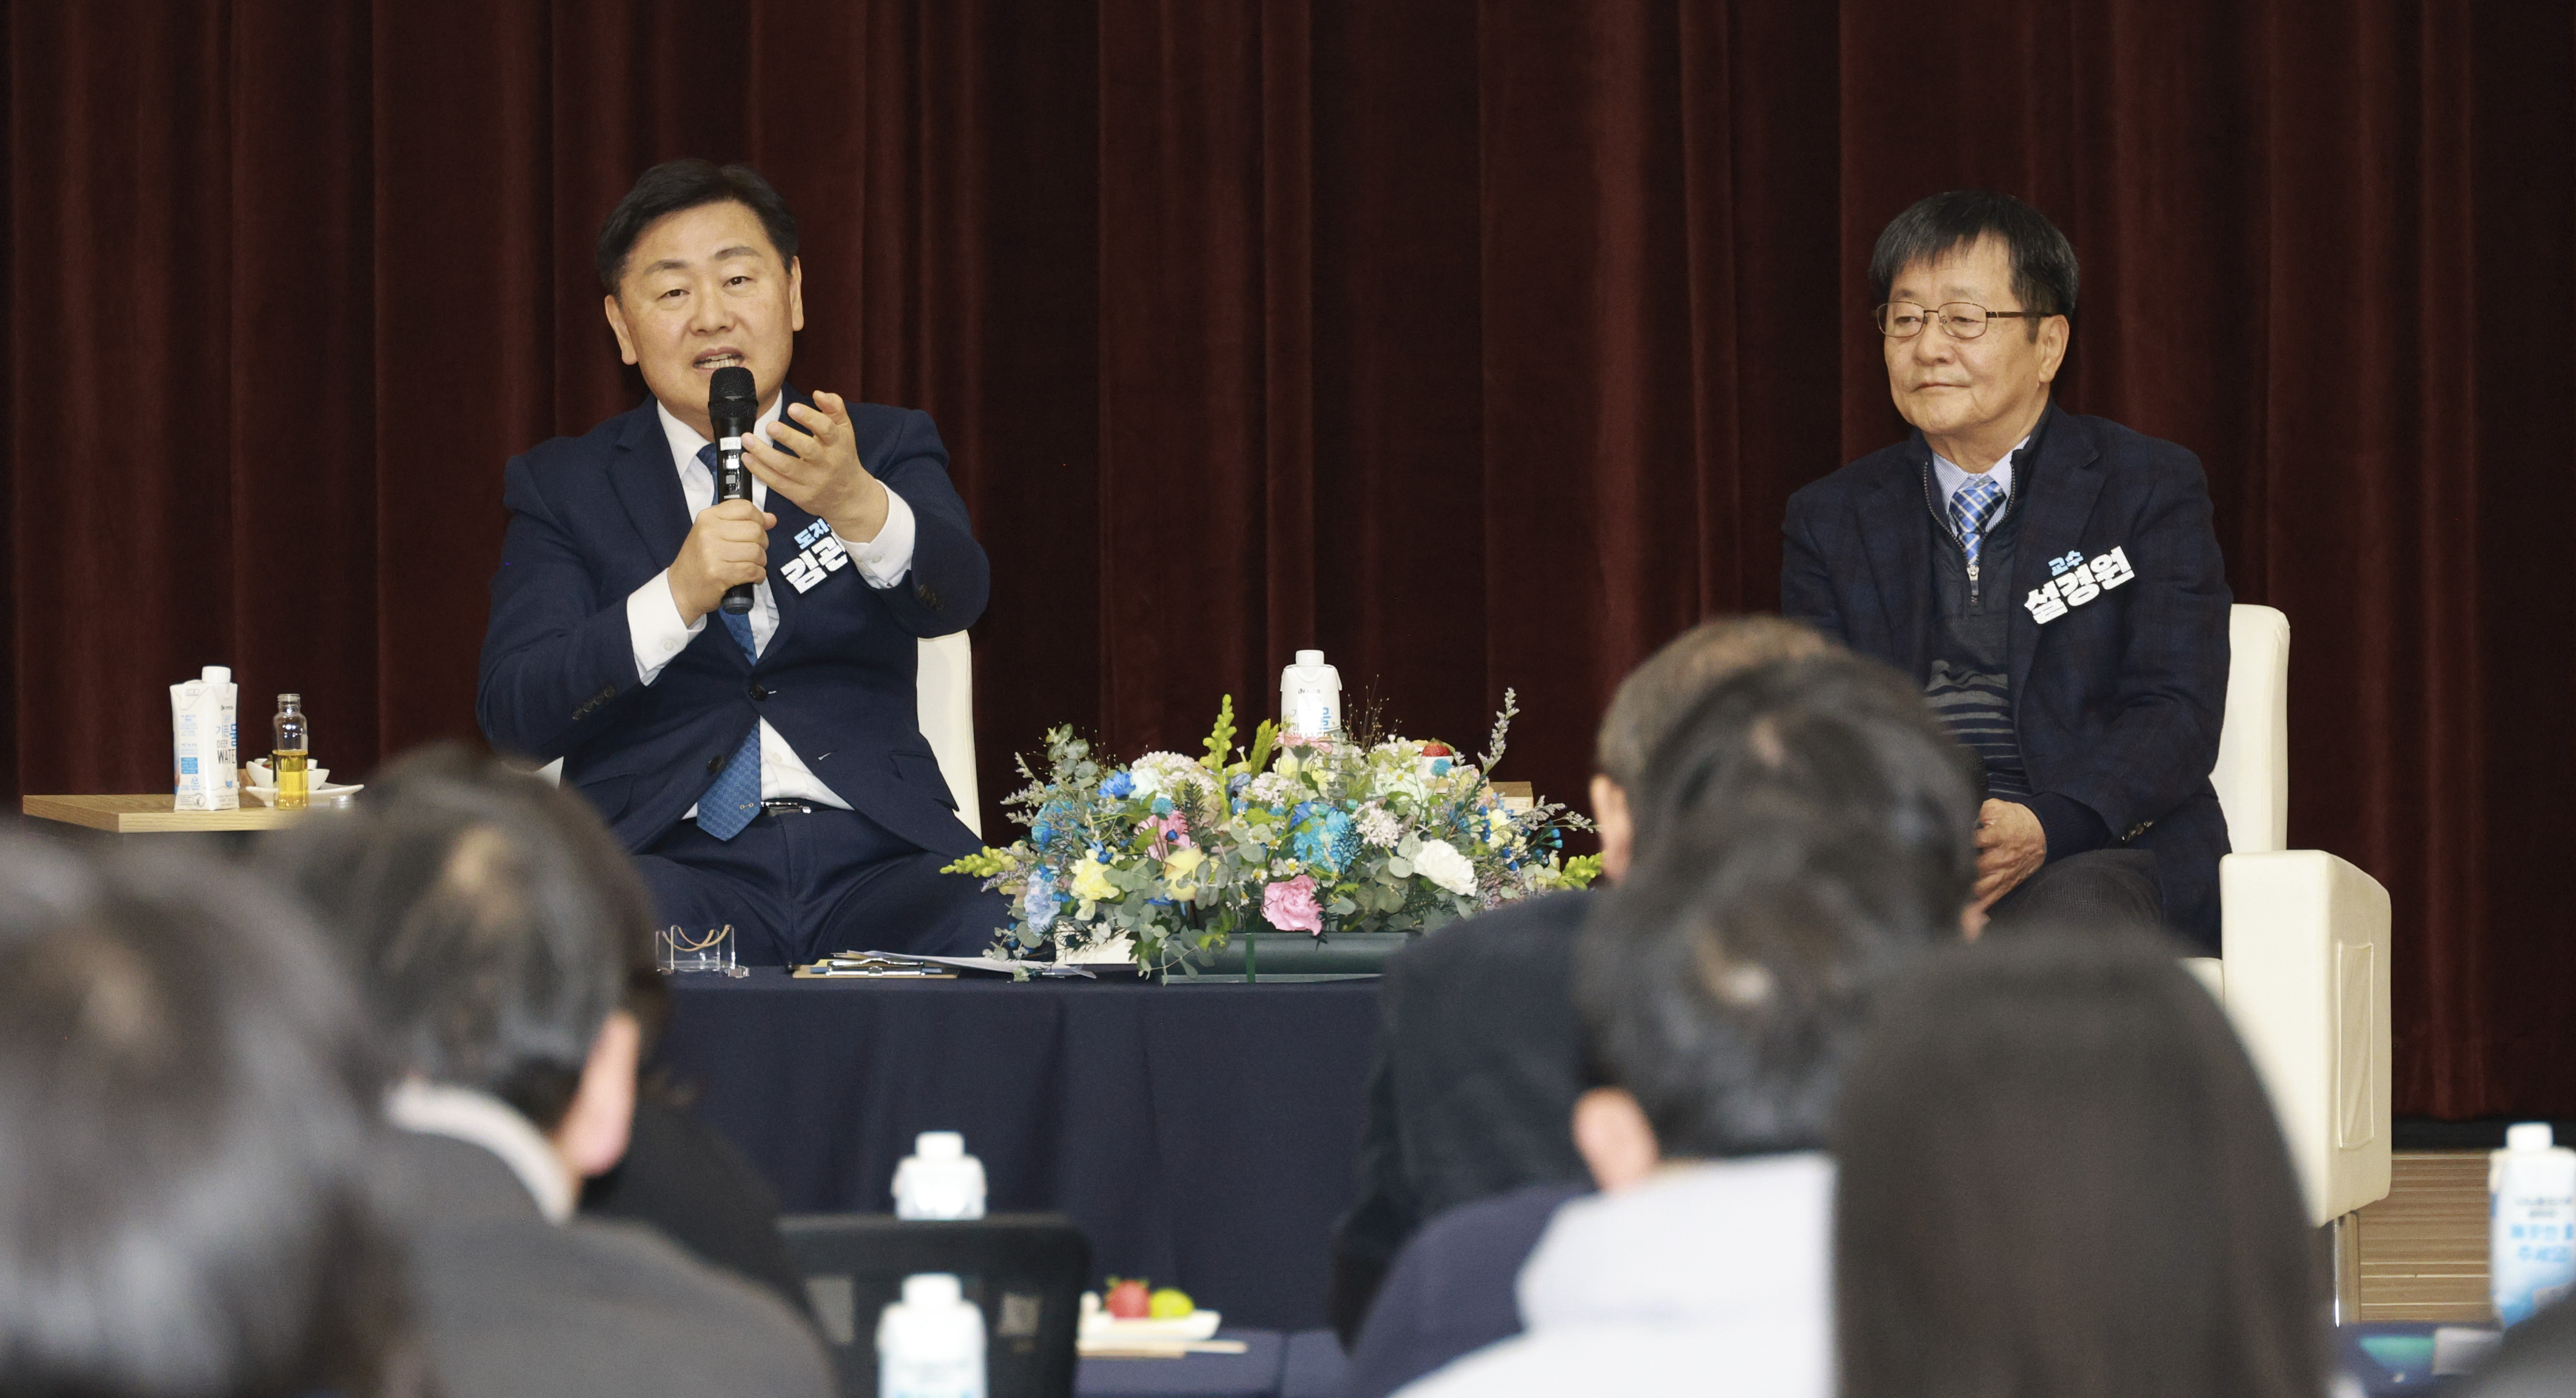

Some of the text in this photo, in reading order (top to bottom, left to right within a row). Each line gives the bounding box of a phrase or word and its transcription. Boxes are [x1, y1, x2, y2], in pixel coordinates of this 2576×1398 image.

[794, 518, 830, 550] 도지
[2048, 550, 2084, 576] 교수
[2024, 546, 2135, 624] 설경원
[217, 740, 228, 748] DEEP
[217, 749, 236, 764] WATE
